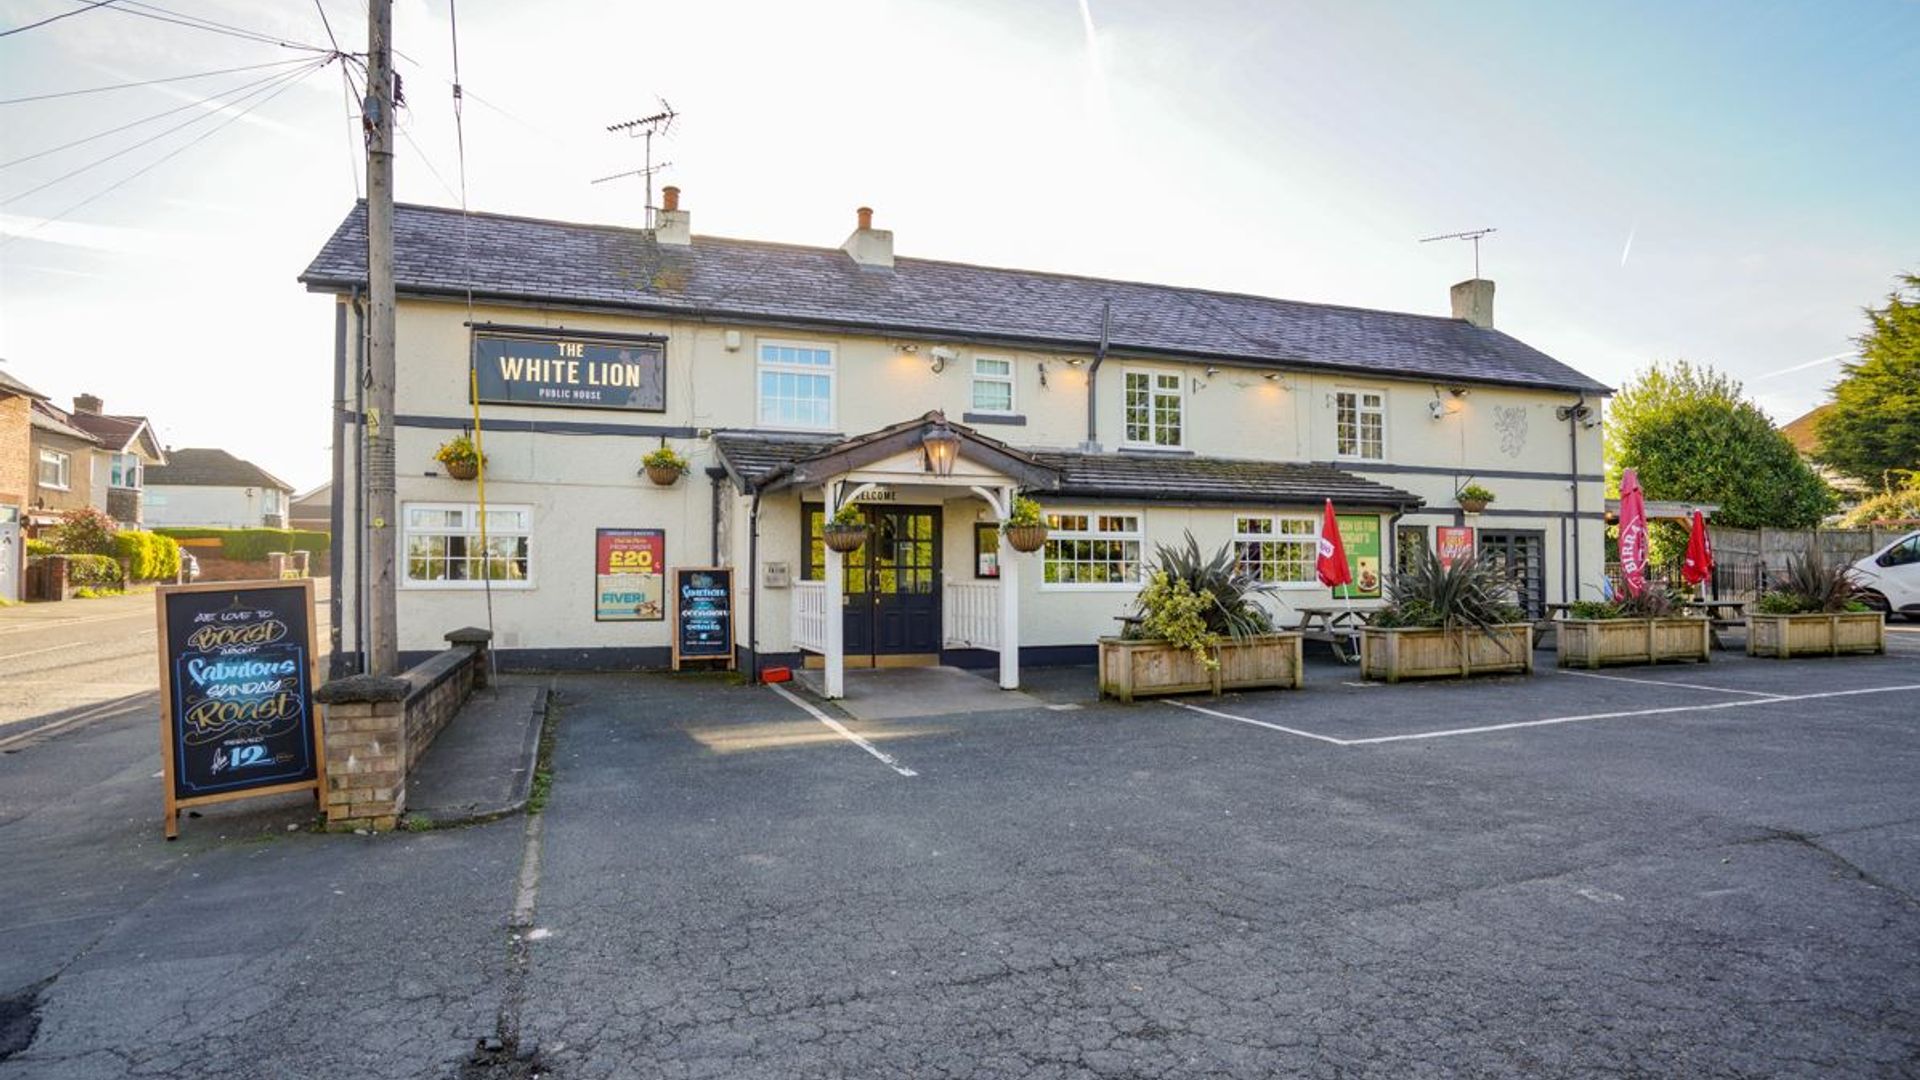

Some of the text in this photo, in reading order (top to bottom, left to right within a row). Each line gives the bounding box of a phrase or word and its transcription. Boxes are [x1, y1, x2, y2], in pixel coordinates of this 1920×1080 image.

[557, 343, 584, 358] THE
[500, 356, 640, 388] WHITE LION
[538, 387, 601, 400] PUBLIC HOUSE
[610, 550, 652, 566] £20
[602, 592, 645, 603] FIVER!
[221, 611, 251, 621] LOVE
[256, 609, 274, 618] TO
[206, 680, 282, 698] SUNDAY
[230, 744, 276, 768] 12
